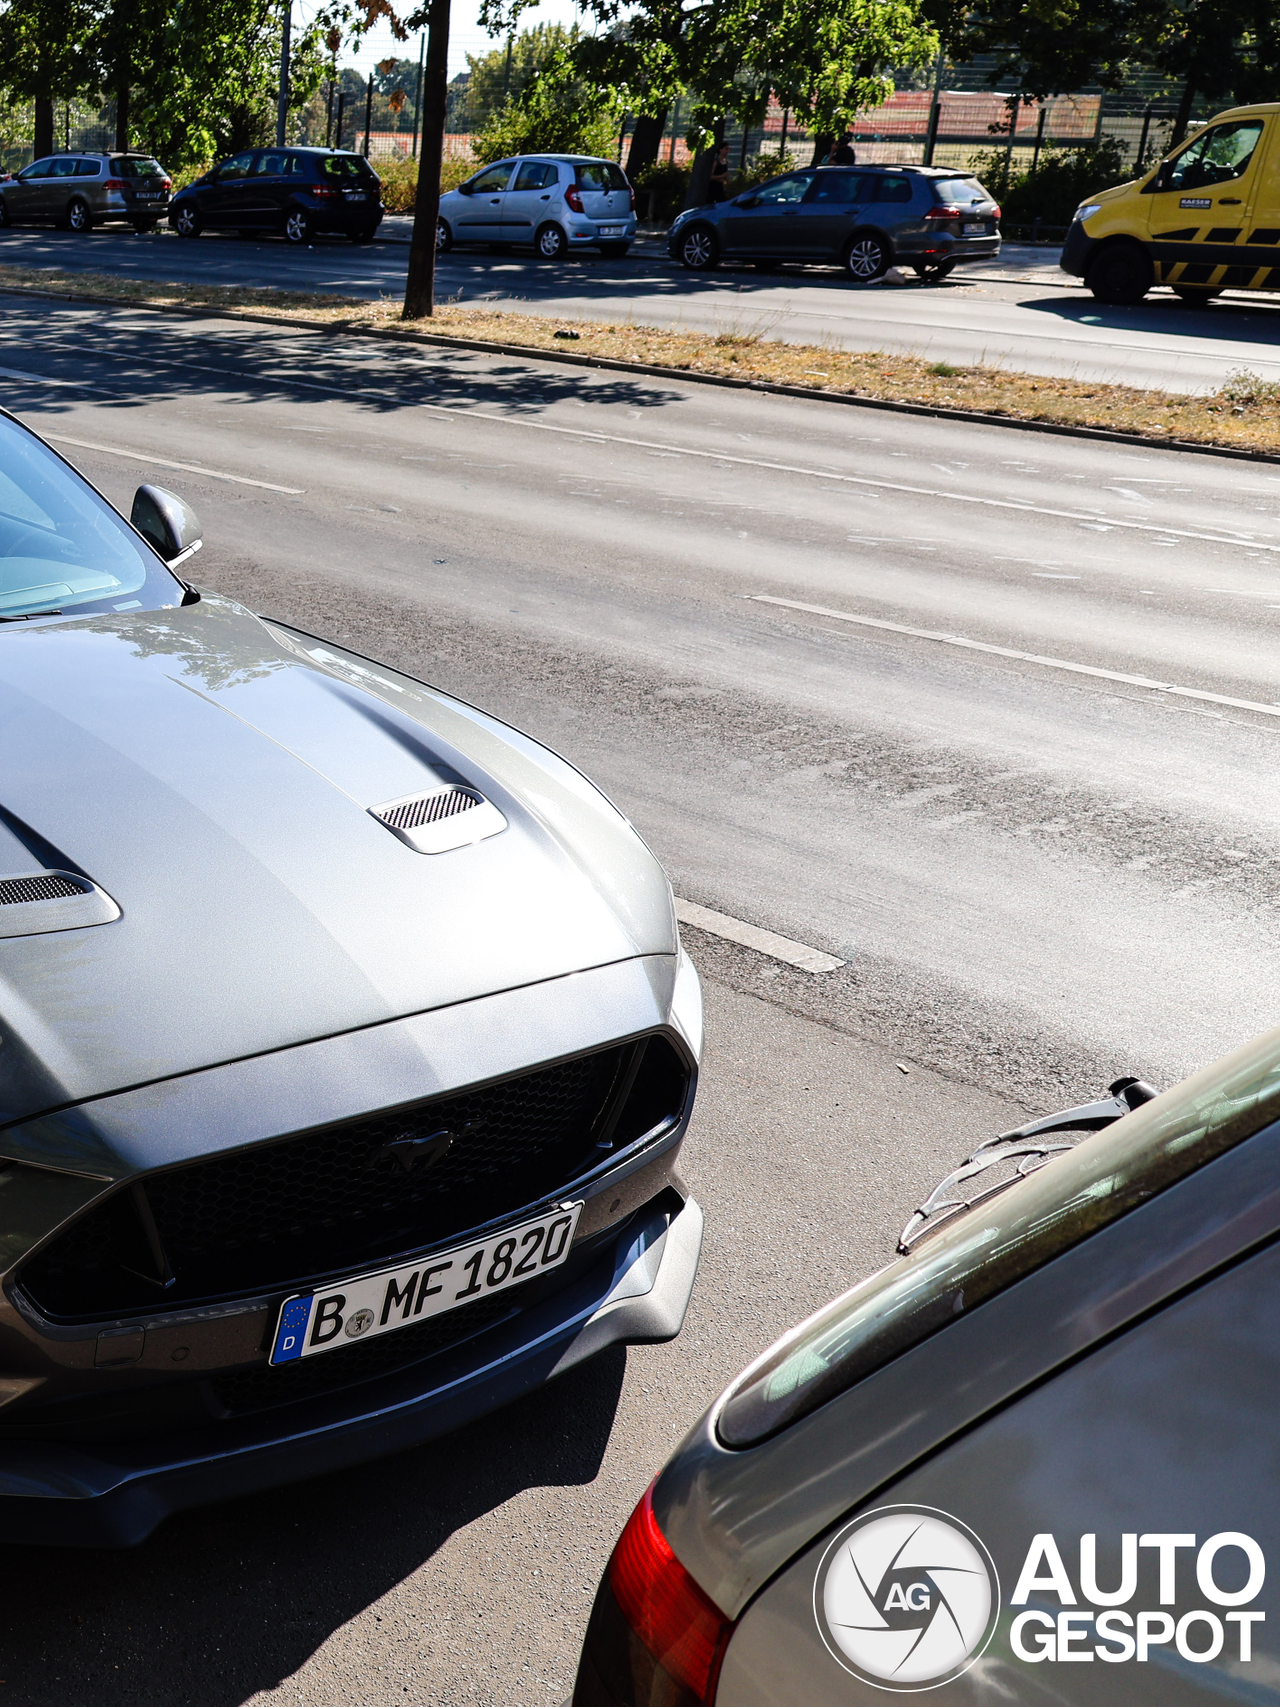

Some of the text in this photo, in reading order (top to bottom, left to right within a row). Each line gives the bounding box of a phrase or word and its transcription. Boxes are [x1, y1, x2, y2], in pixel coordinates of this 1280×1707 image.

[309, 1294, 346, 1347] B
[379, 1260, 453, 1326] MF
[455, 1214, 573, 1301] 1820
[282, 1336, 296, 1351] D
